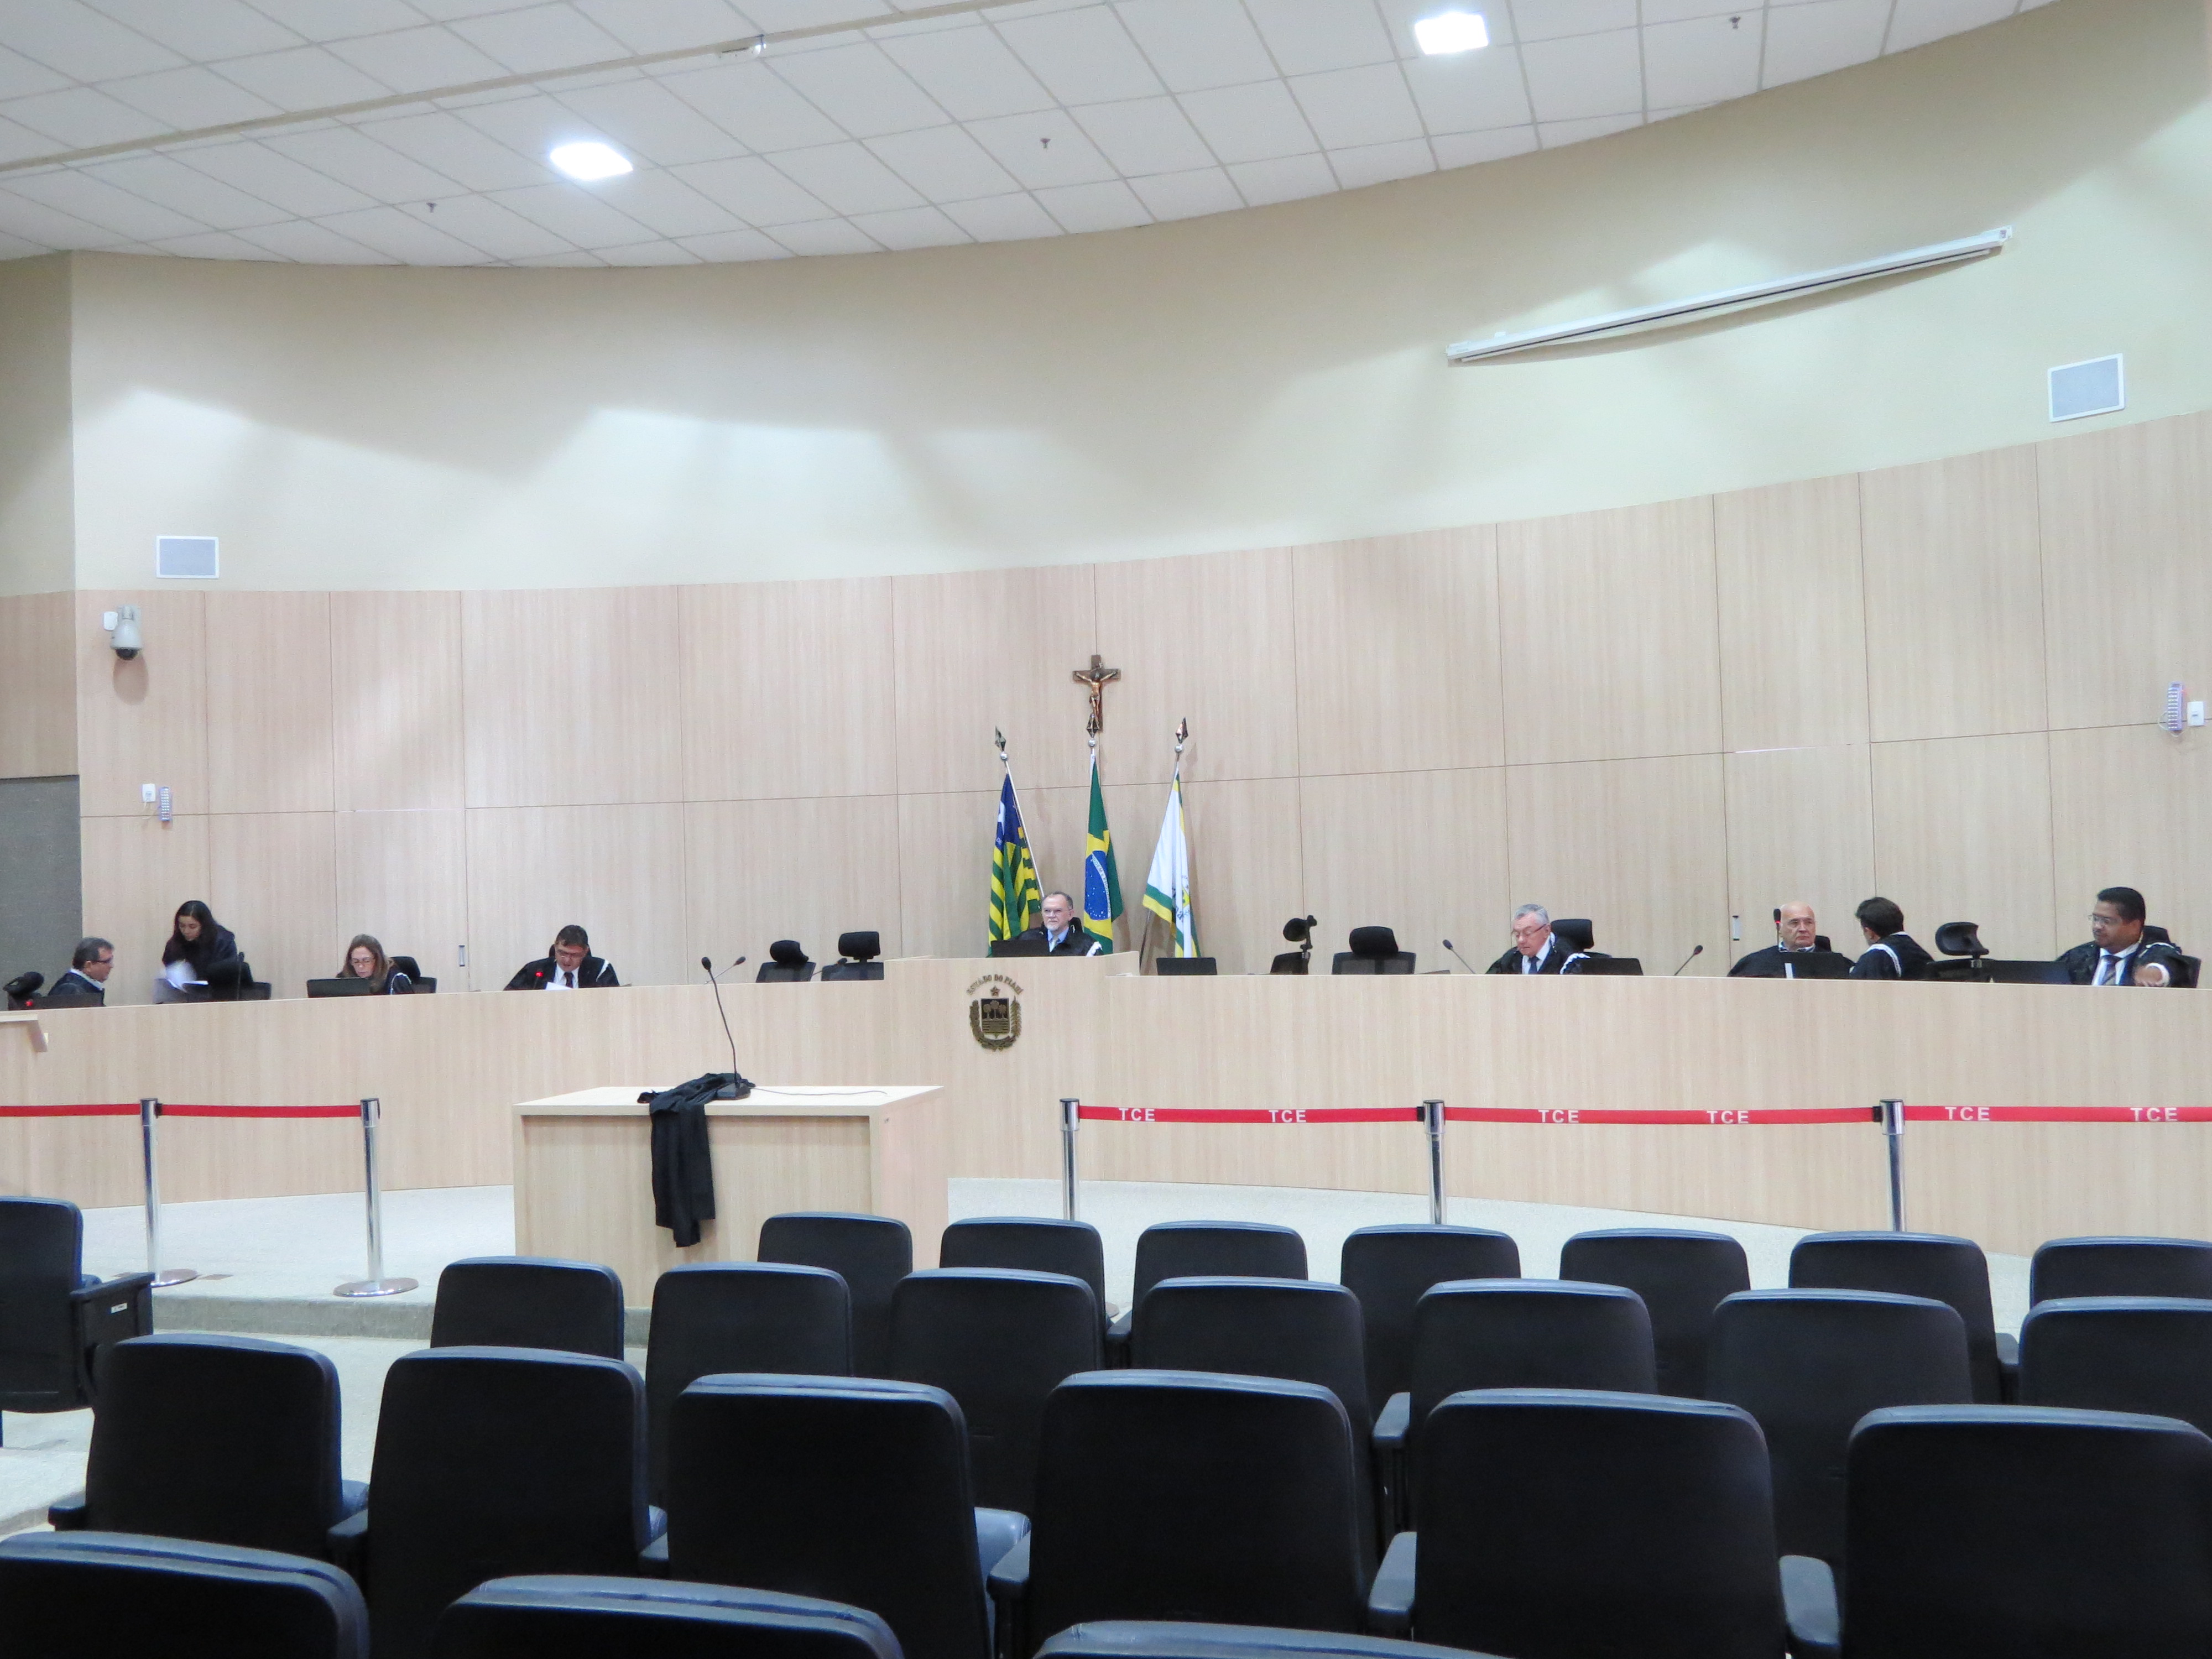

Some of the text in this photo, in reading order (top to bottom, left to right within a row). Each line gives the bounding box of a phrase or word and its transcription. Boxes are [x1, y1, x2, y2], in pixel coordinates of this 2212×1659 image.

[966, 974, 992, 995] ESTADO
[994, 974, 1003, 982] DO
[1118, 1108, 1155, 1121] TCE
[1268, 1109, 1306, 1123] TCE
[1538, 1109, 1579, 1123] TCE
[1706, 1110, 1749, 1124] TCE
[1944, 1107, 1990, 1121] TCE
[2130, 1107, 2178, 1122] TCE
